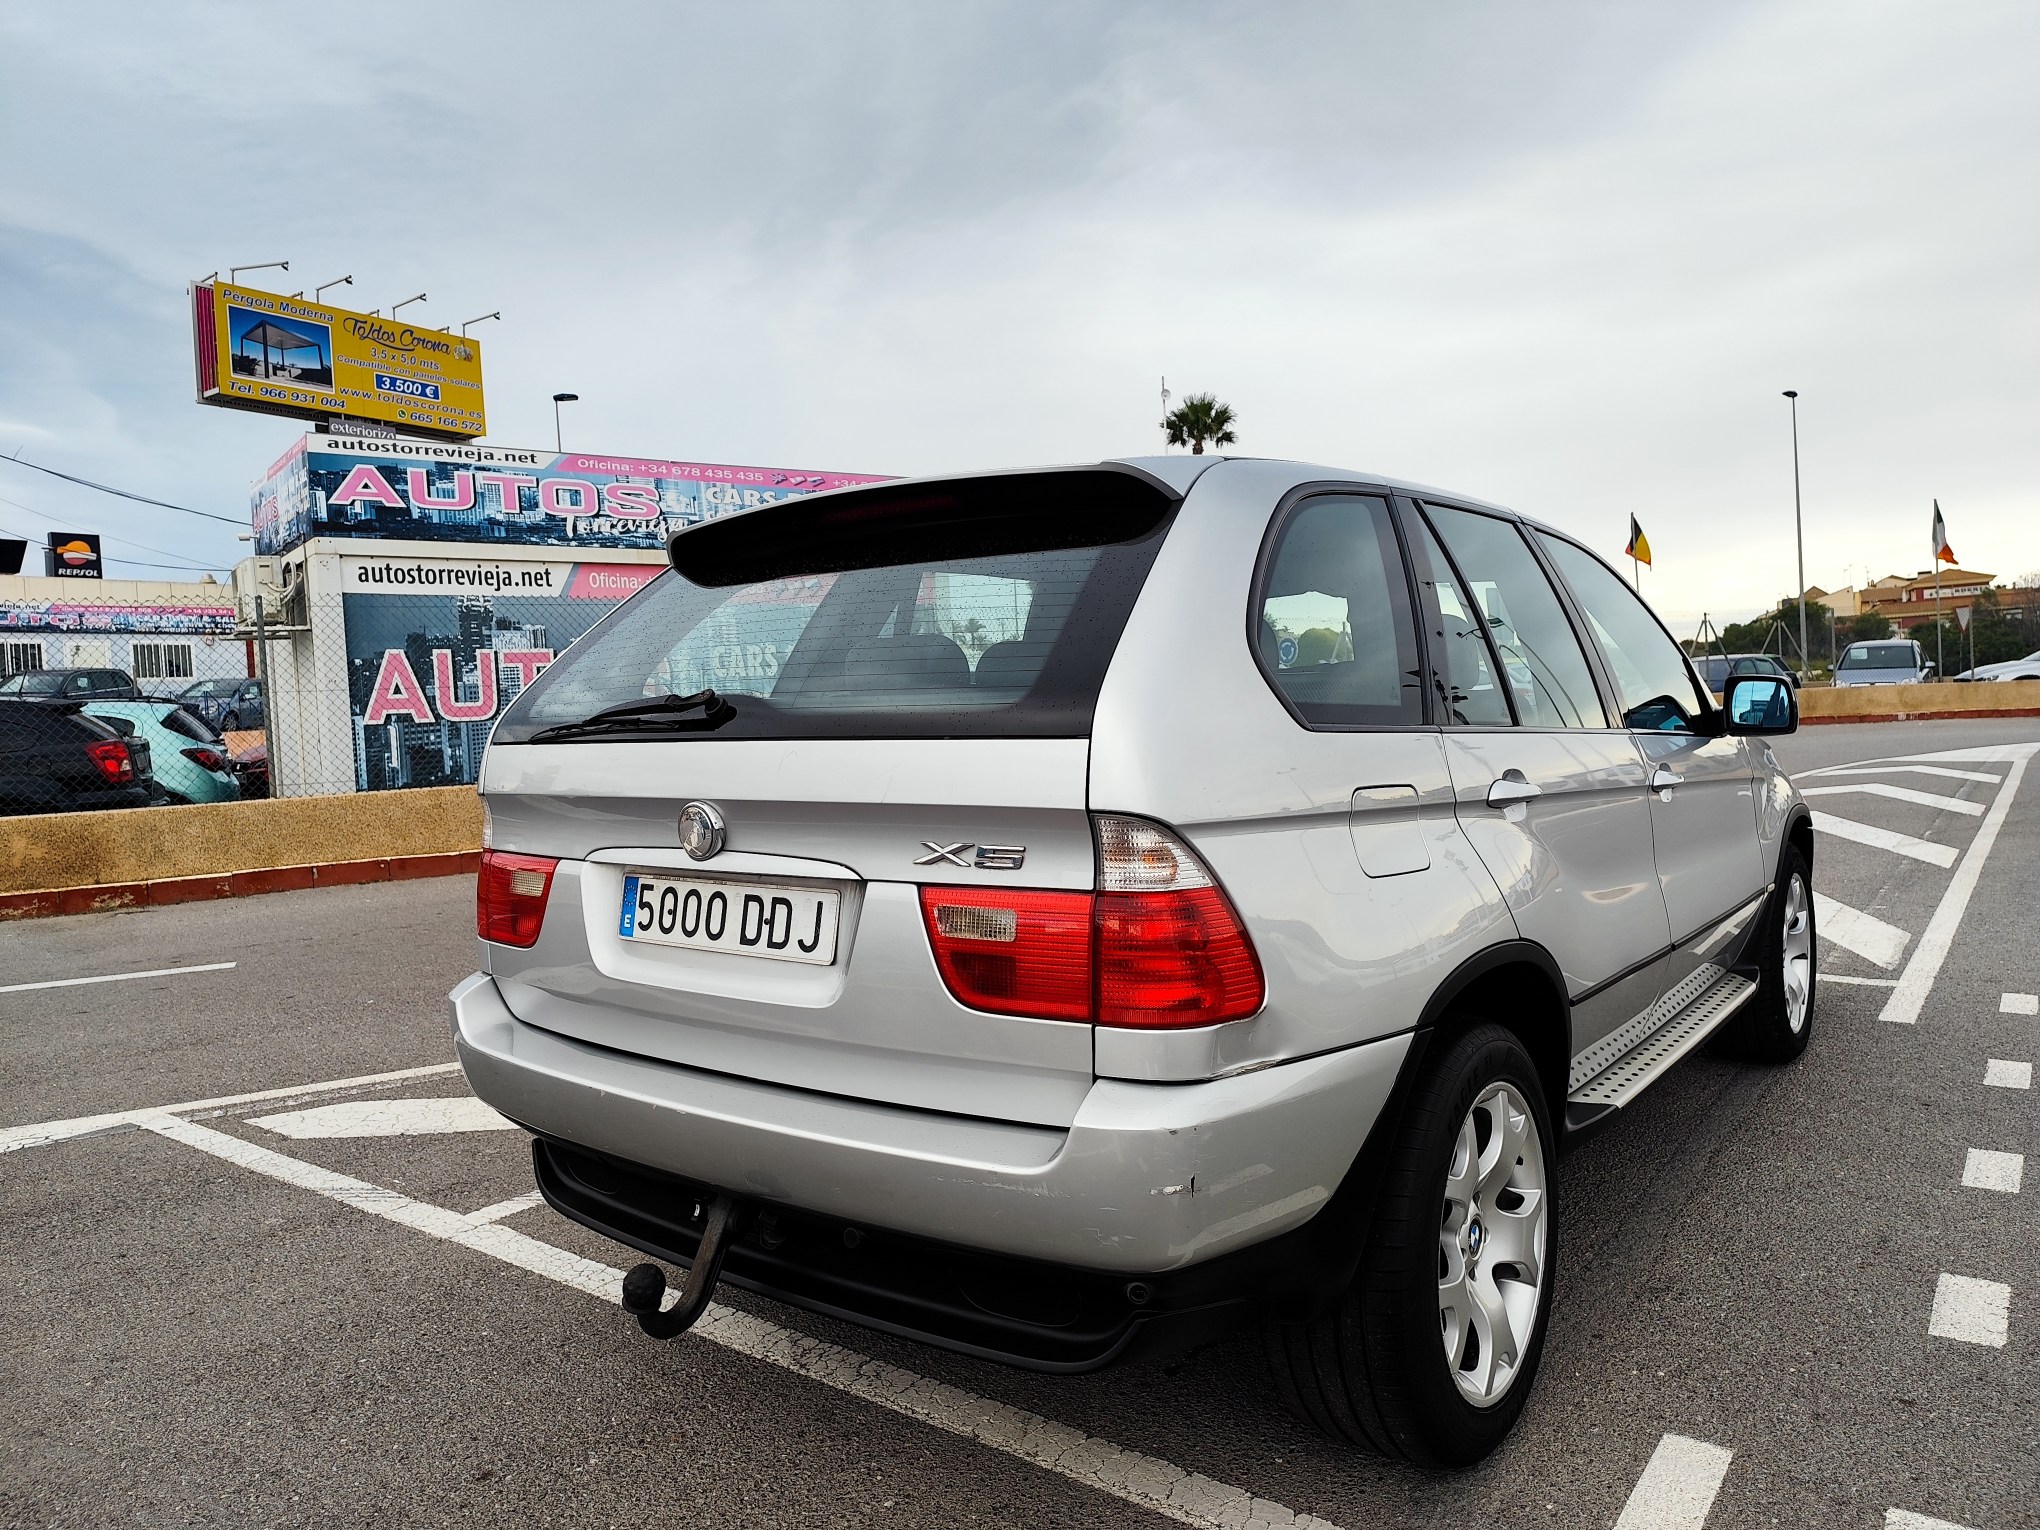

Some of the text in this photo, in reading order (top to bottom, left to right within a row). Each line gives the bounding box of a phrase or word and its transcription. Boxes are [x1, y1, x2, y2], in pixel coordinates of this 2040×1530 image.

[223, 289, 334, 322] Pérgola Moderna
[343, 317, 451, 355] Toldos Corona
[337, 354, 480, 390] Compatible con paneles solares
[371, 347, 387, 360] 3,5
[401, 353, 417, 366] 5,0
[420, 359, 442, 371] mts.
[228, 381, 345, 409] Tel. 966 931 004
[381, 377, 435, 398] 3.500 €
[339, 387, 482, 419] www.toldoscorona.es
[410, 412, 482, 432] 665 166 572
[327, 439, 538, 464] autostorrevieja.net
[577, 459, 634, 472] Oficina:
[639, 465, 668, 474] +34
[672, 467, 700, 476] 678
[705, 469, 733, 479] 435
[736, 471, 764, 481] 435
[328, 463, 662, 520] AUTOS
[706, 487, 777, 506] CARS
[560, 514, 688, 542] Torrevieja
[58, 568, 99, 577] REPSOL
[358, 563, 553, 592] autostorrevieja.net
[589, 572, 642, 588] Oficina:
[712, 643, 779, 678] CARS
[912, 840, 1027, 870] X5
[623, 914, 631, 928] E
[637, 883, 824, 953] 5000 DDJ
